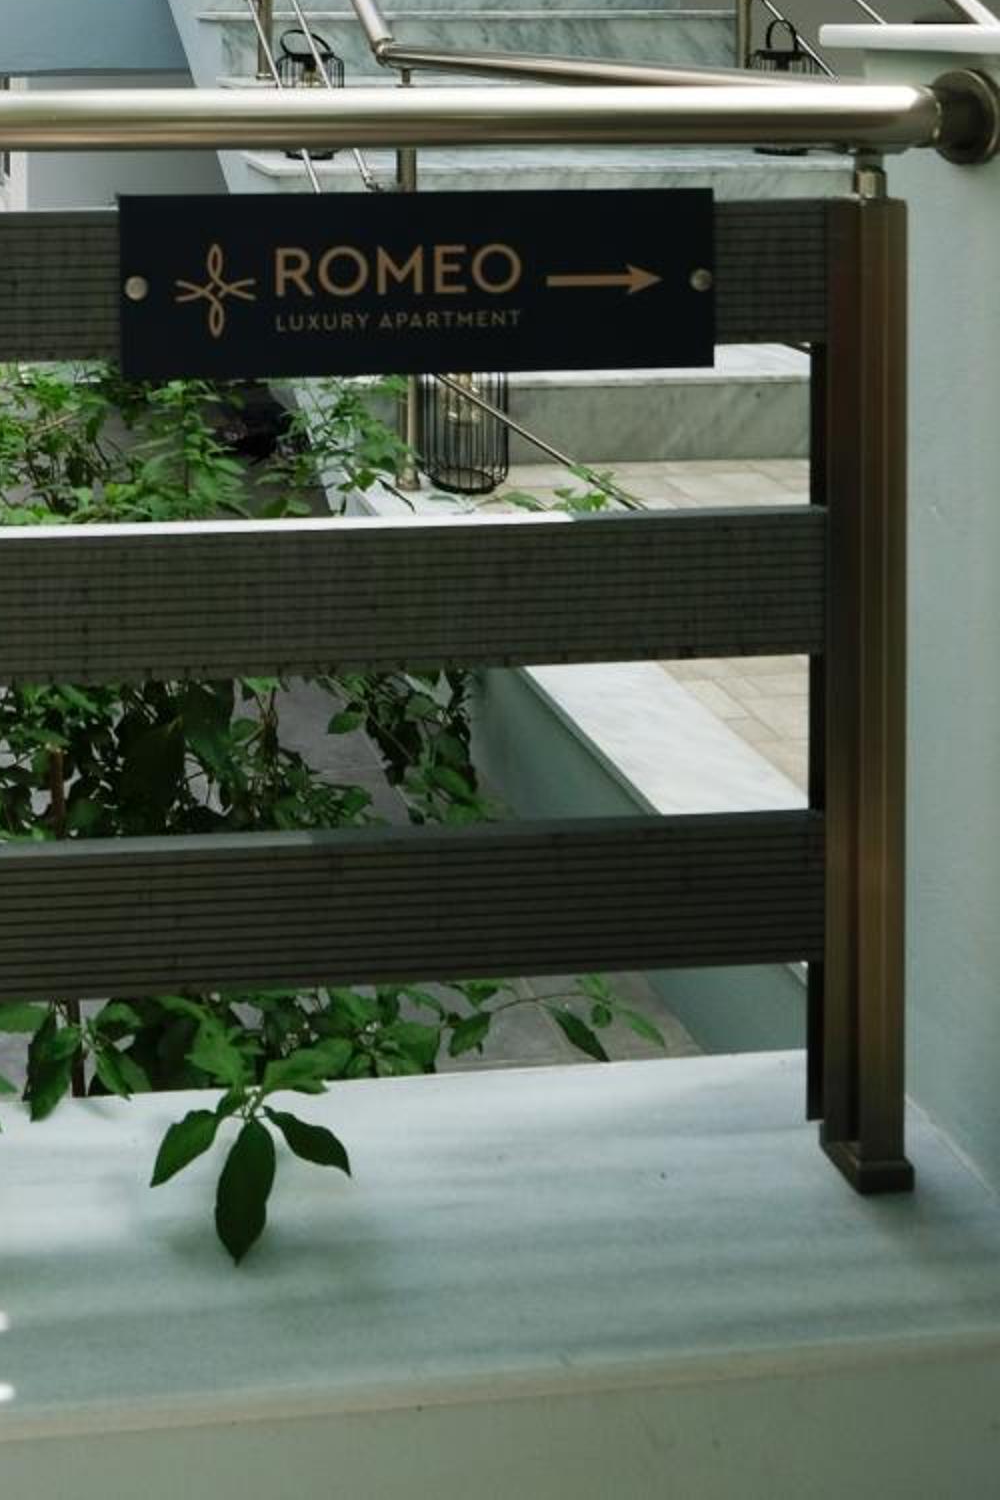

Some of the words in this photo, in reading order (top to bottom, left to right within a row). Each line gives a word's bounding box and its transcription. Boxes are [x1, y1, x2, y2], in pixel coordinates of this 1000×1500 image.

[274, 243, 522, 297] ROMEO
[275, 313, 370, 332] LUXURY
[378, 309, 523, 330] APARTMENT
